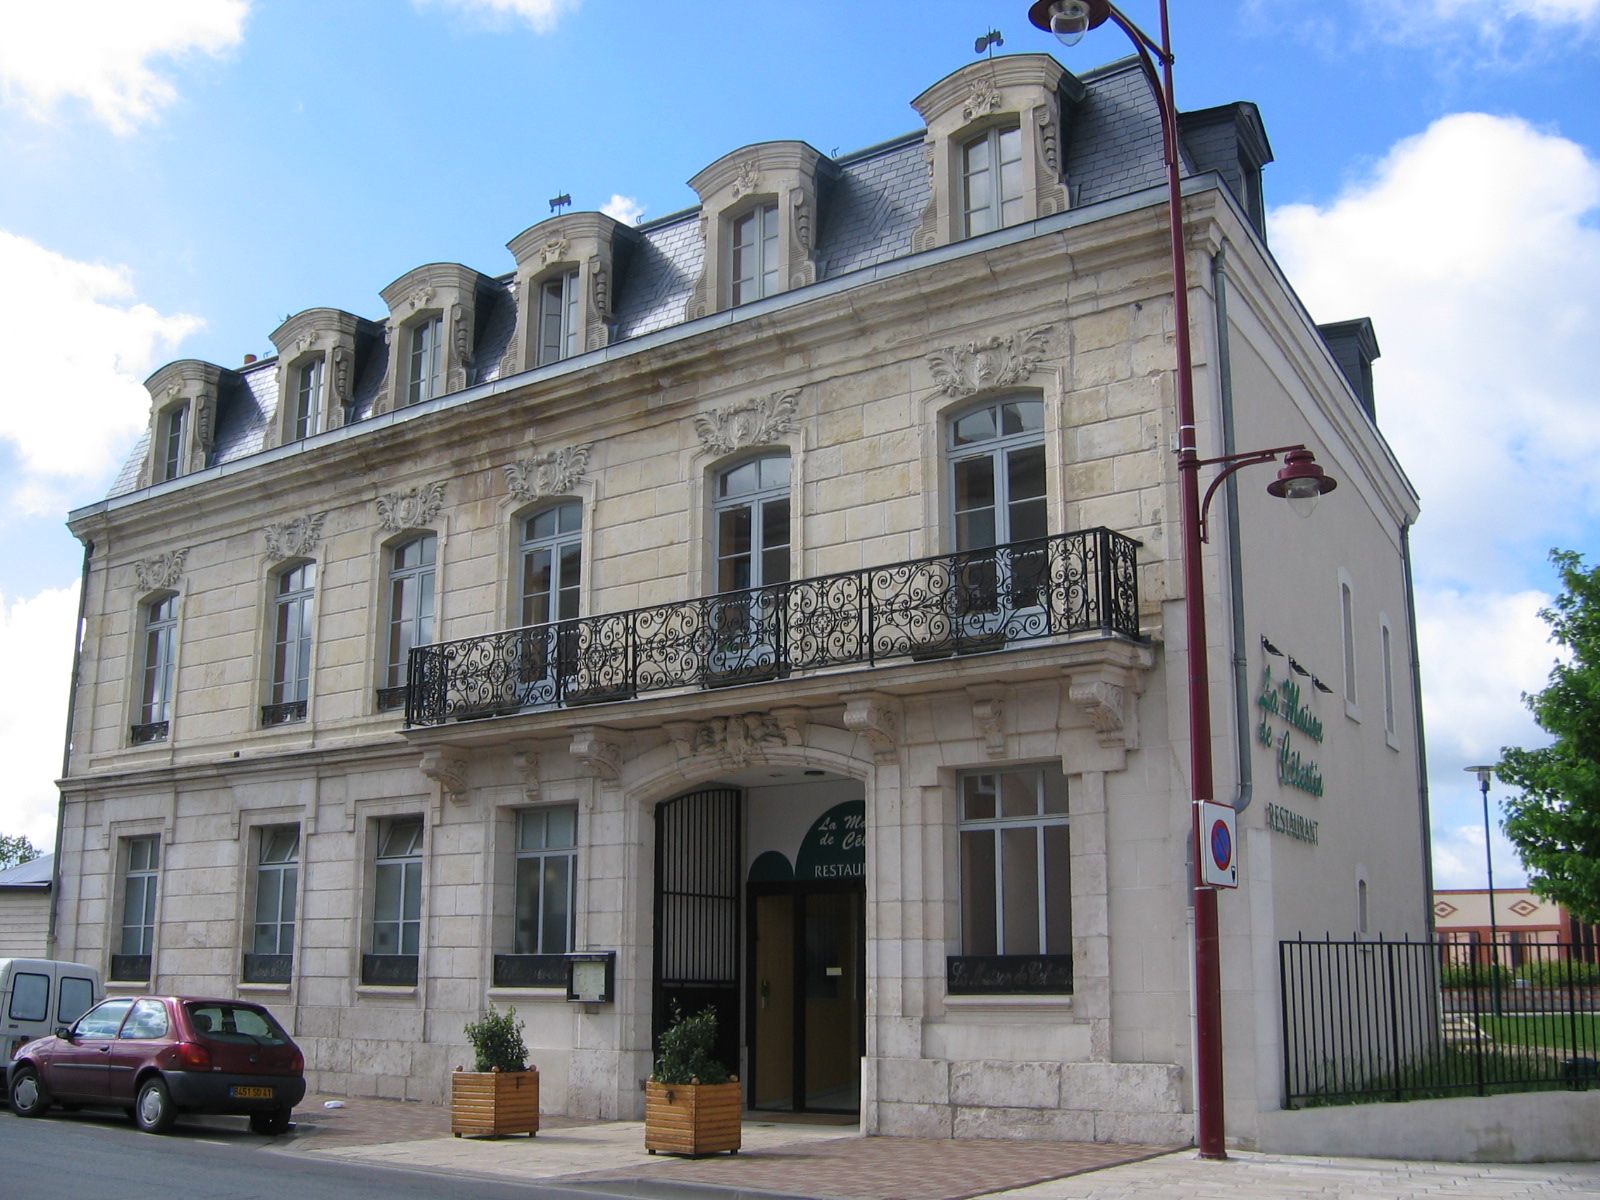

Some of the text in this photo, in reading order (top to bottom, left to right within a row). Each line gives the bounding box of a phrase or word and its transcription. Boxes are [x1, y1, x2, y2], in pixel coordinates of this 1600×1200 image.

[1259, 664, 1324, 744] La Maison
[1260, 711, 1272, 748] de
[818, 816, 837, 831] La
[1268, 802, 1319, 846] RESTAURANT
[819, 832, 834, 846] de
[814, 862, 865, 878] RESTAU
[263, 1088, 271, 1097] 41
